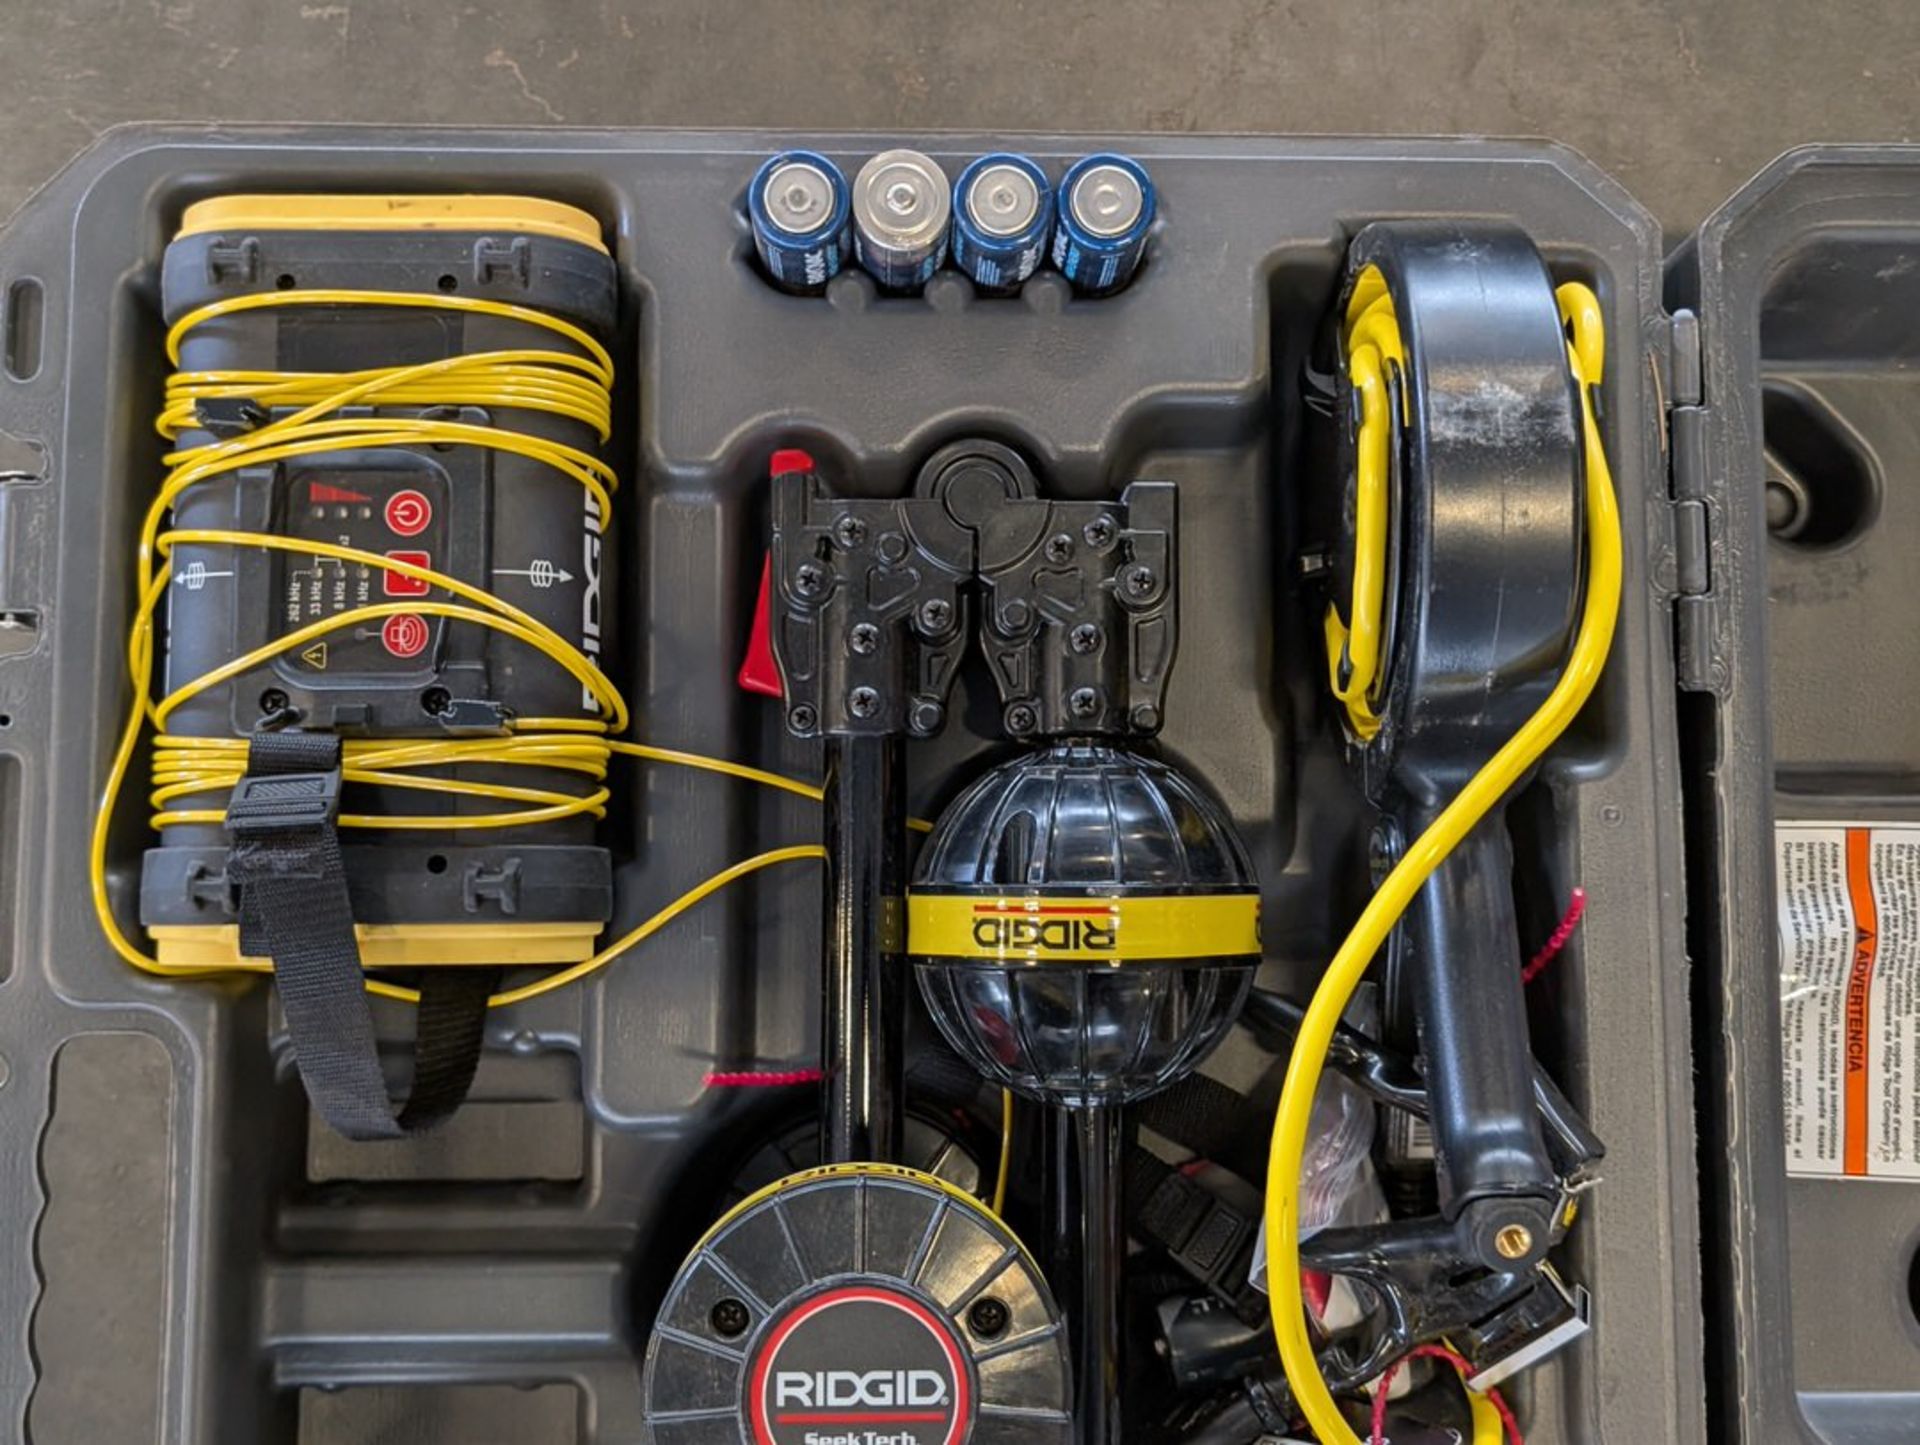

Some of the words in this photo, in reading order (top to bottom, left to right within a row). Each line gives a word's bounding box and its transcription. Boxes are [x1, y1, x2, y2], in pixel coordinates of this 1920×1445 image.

[289, 581, 301, 601] kHz
[310, 581, 322, 601] kHz
[333, 581, 345, 601] kHz
[357, 581, 368, 601] kHz
[288, 603, 300, 622] 262
[309, 603, 322, 615] 33
[972, 917, 1116, 950] RIDGID
[1848, 949, 1871, 1073] ADVERTENCIA
[775, 1369, 948, 1408] RIDGID
